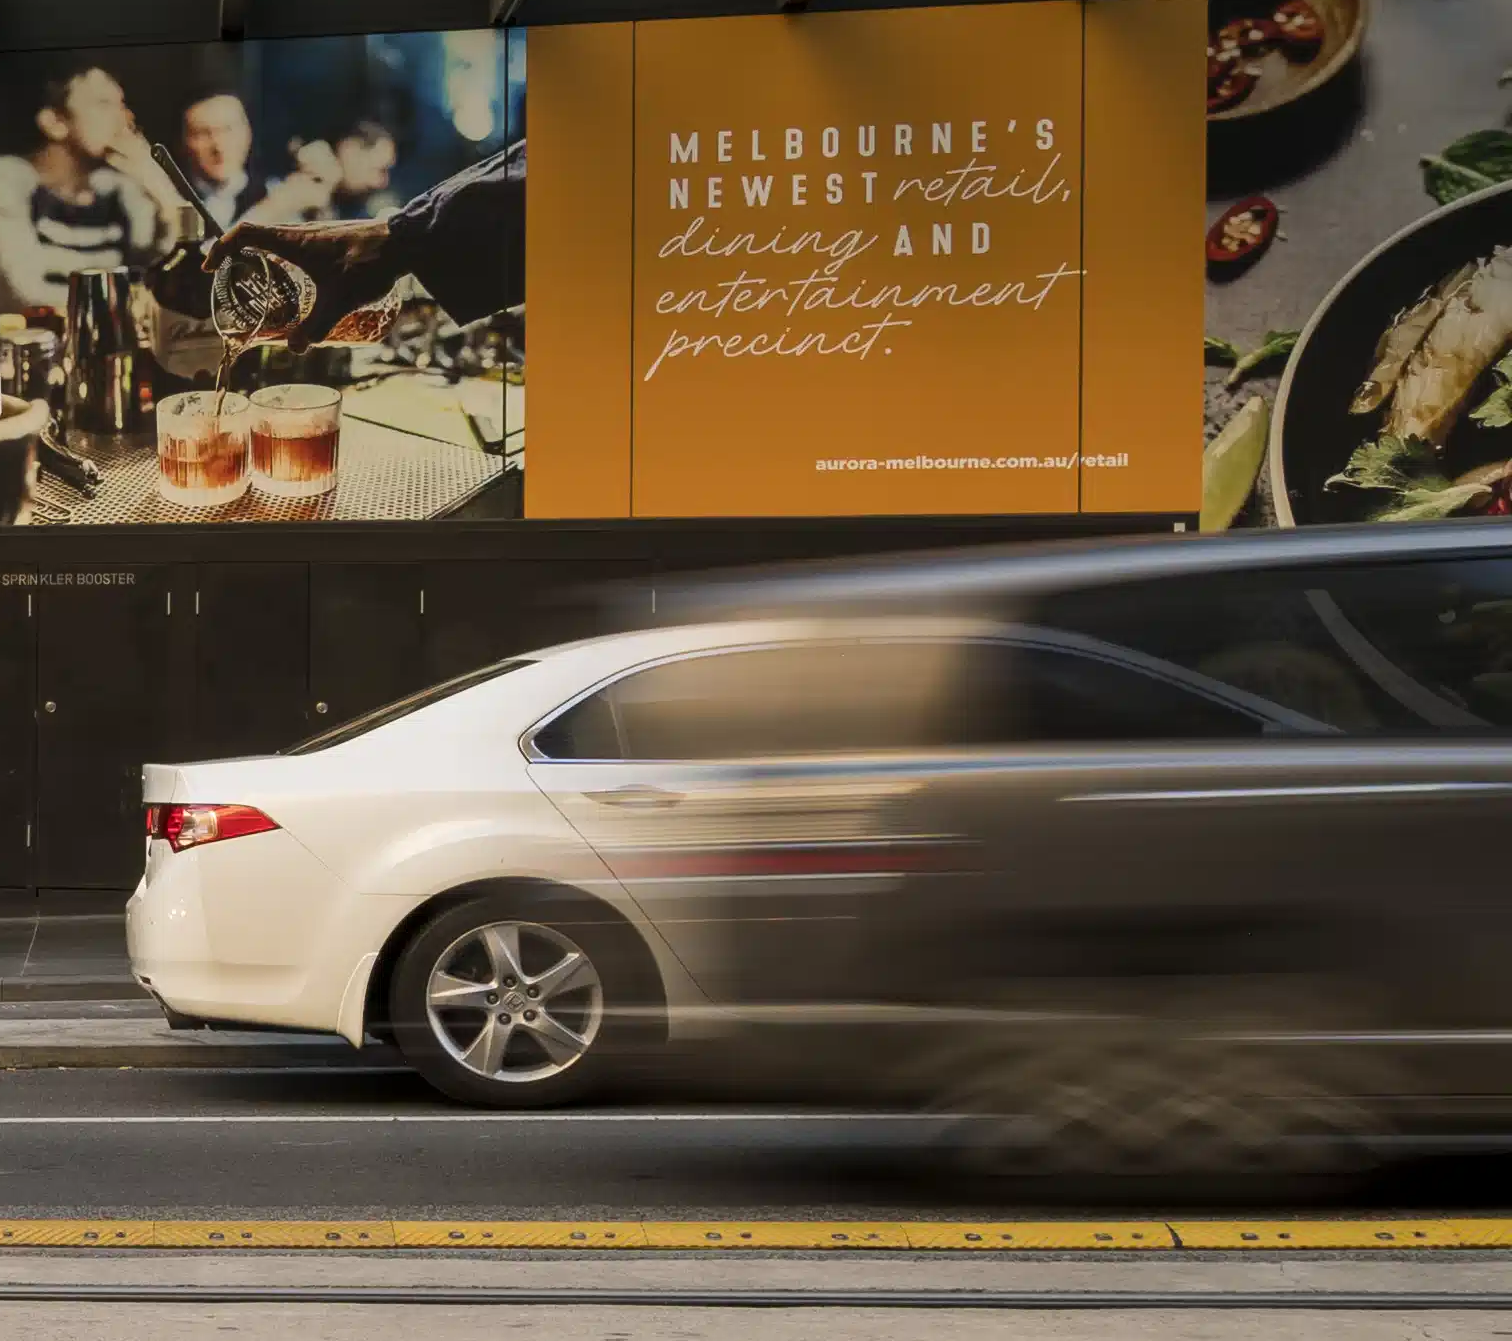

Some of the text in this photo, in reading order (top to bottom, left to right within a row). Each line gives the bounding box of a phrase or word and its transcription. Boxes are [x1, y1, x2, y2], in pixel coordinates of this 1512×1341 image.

[669, 118, 1054, 164] MELBOURNE'S
[669, 152, 1071, 210] NEWEST retail,
[658, 216, 991, 274] dining AND
[656, 262, 1087, 318] entertainment
[643, 312, 912, 382] precinct.
[815, 451, 1128, 472] aurora-melbourne.com.au/retail
[1, 573, 73, 586] SPRINKLER
[76, 573, 135, 586] BOOSTER
